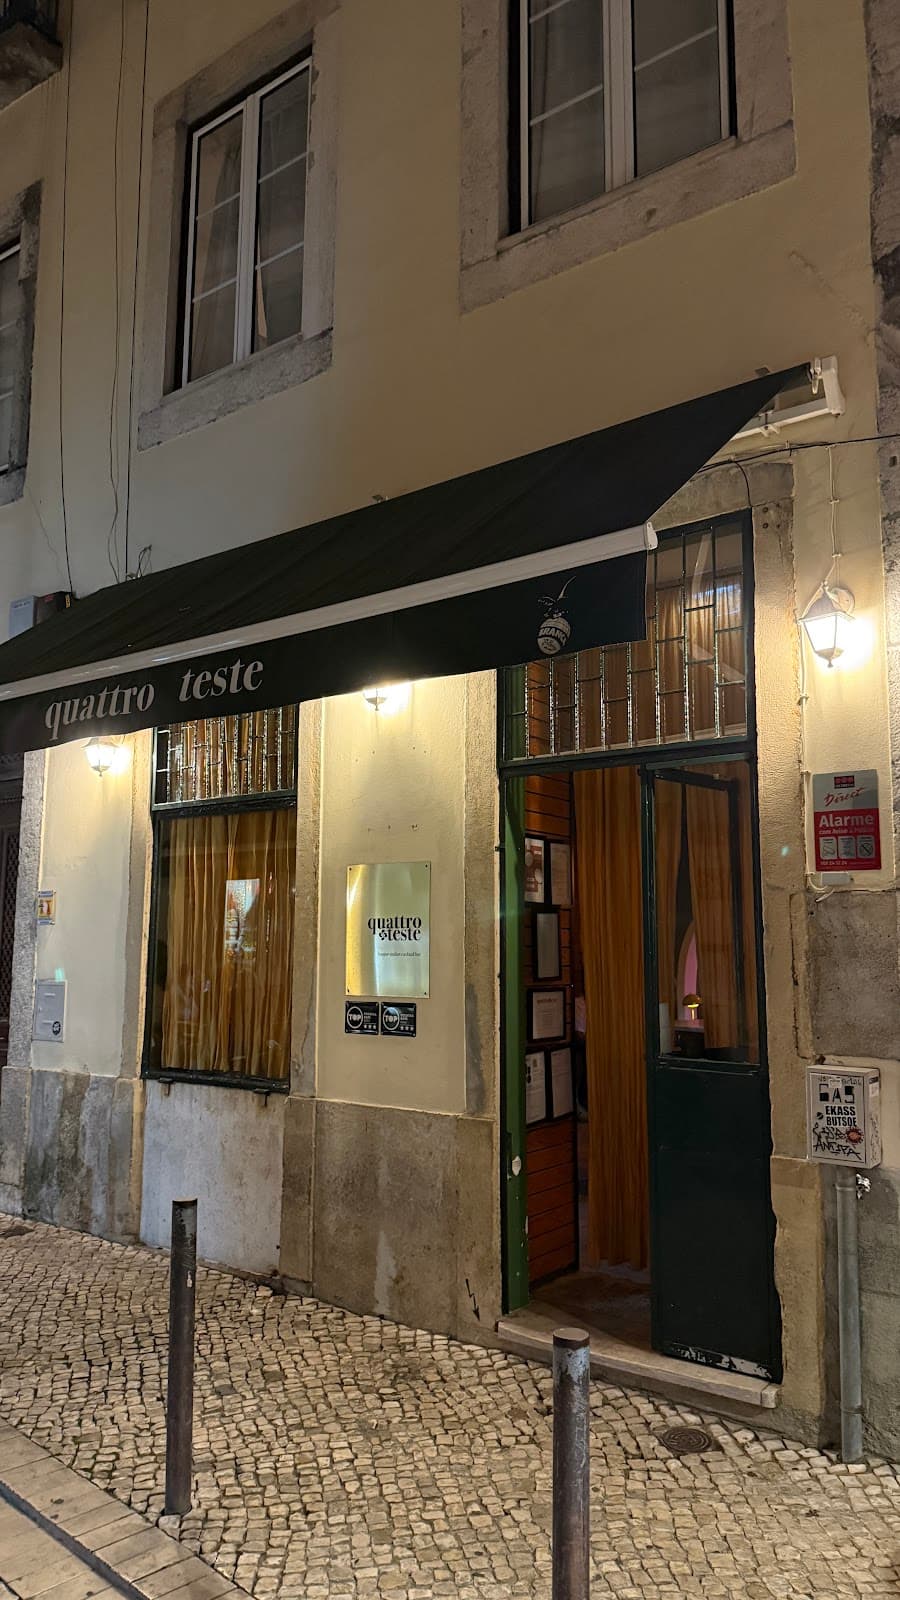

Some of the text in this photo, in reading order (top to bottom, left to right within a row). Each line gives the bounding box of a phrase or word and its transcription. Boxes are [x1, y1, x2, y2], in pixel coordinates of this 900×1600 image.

[44, 658, 264, 741] quattro teste
[819, 813, 874, 828] Alarme
[367, 915, 422, 935] quattro
[388, 928, 421, 941] teste
[348, 1013, 362, 1021] TOP
[384, 1015, 398, 1023] TOP
[825, 1105, 856, 1116] EKASS
